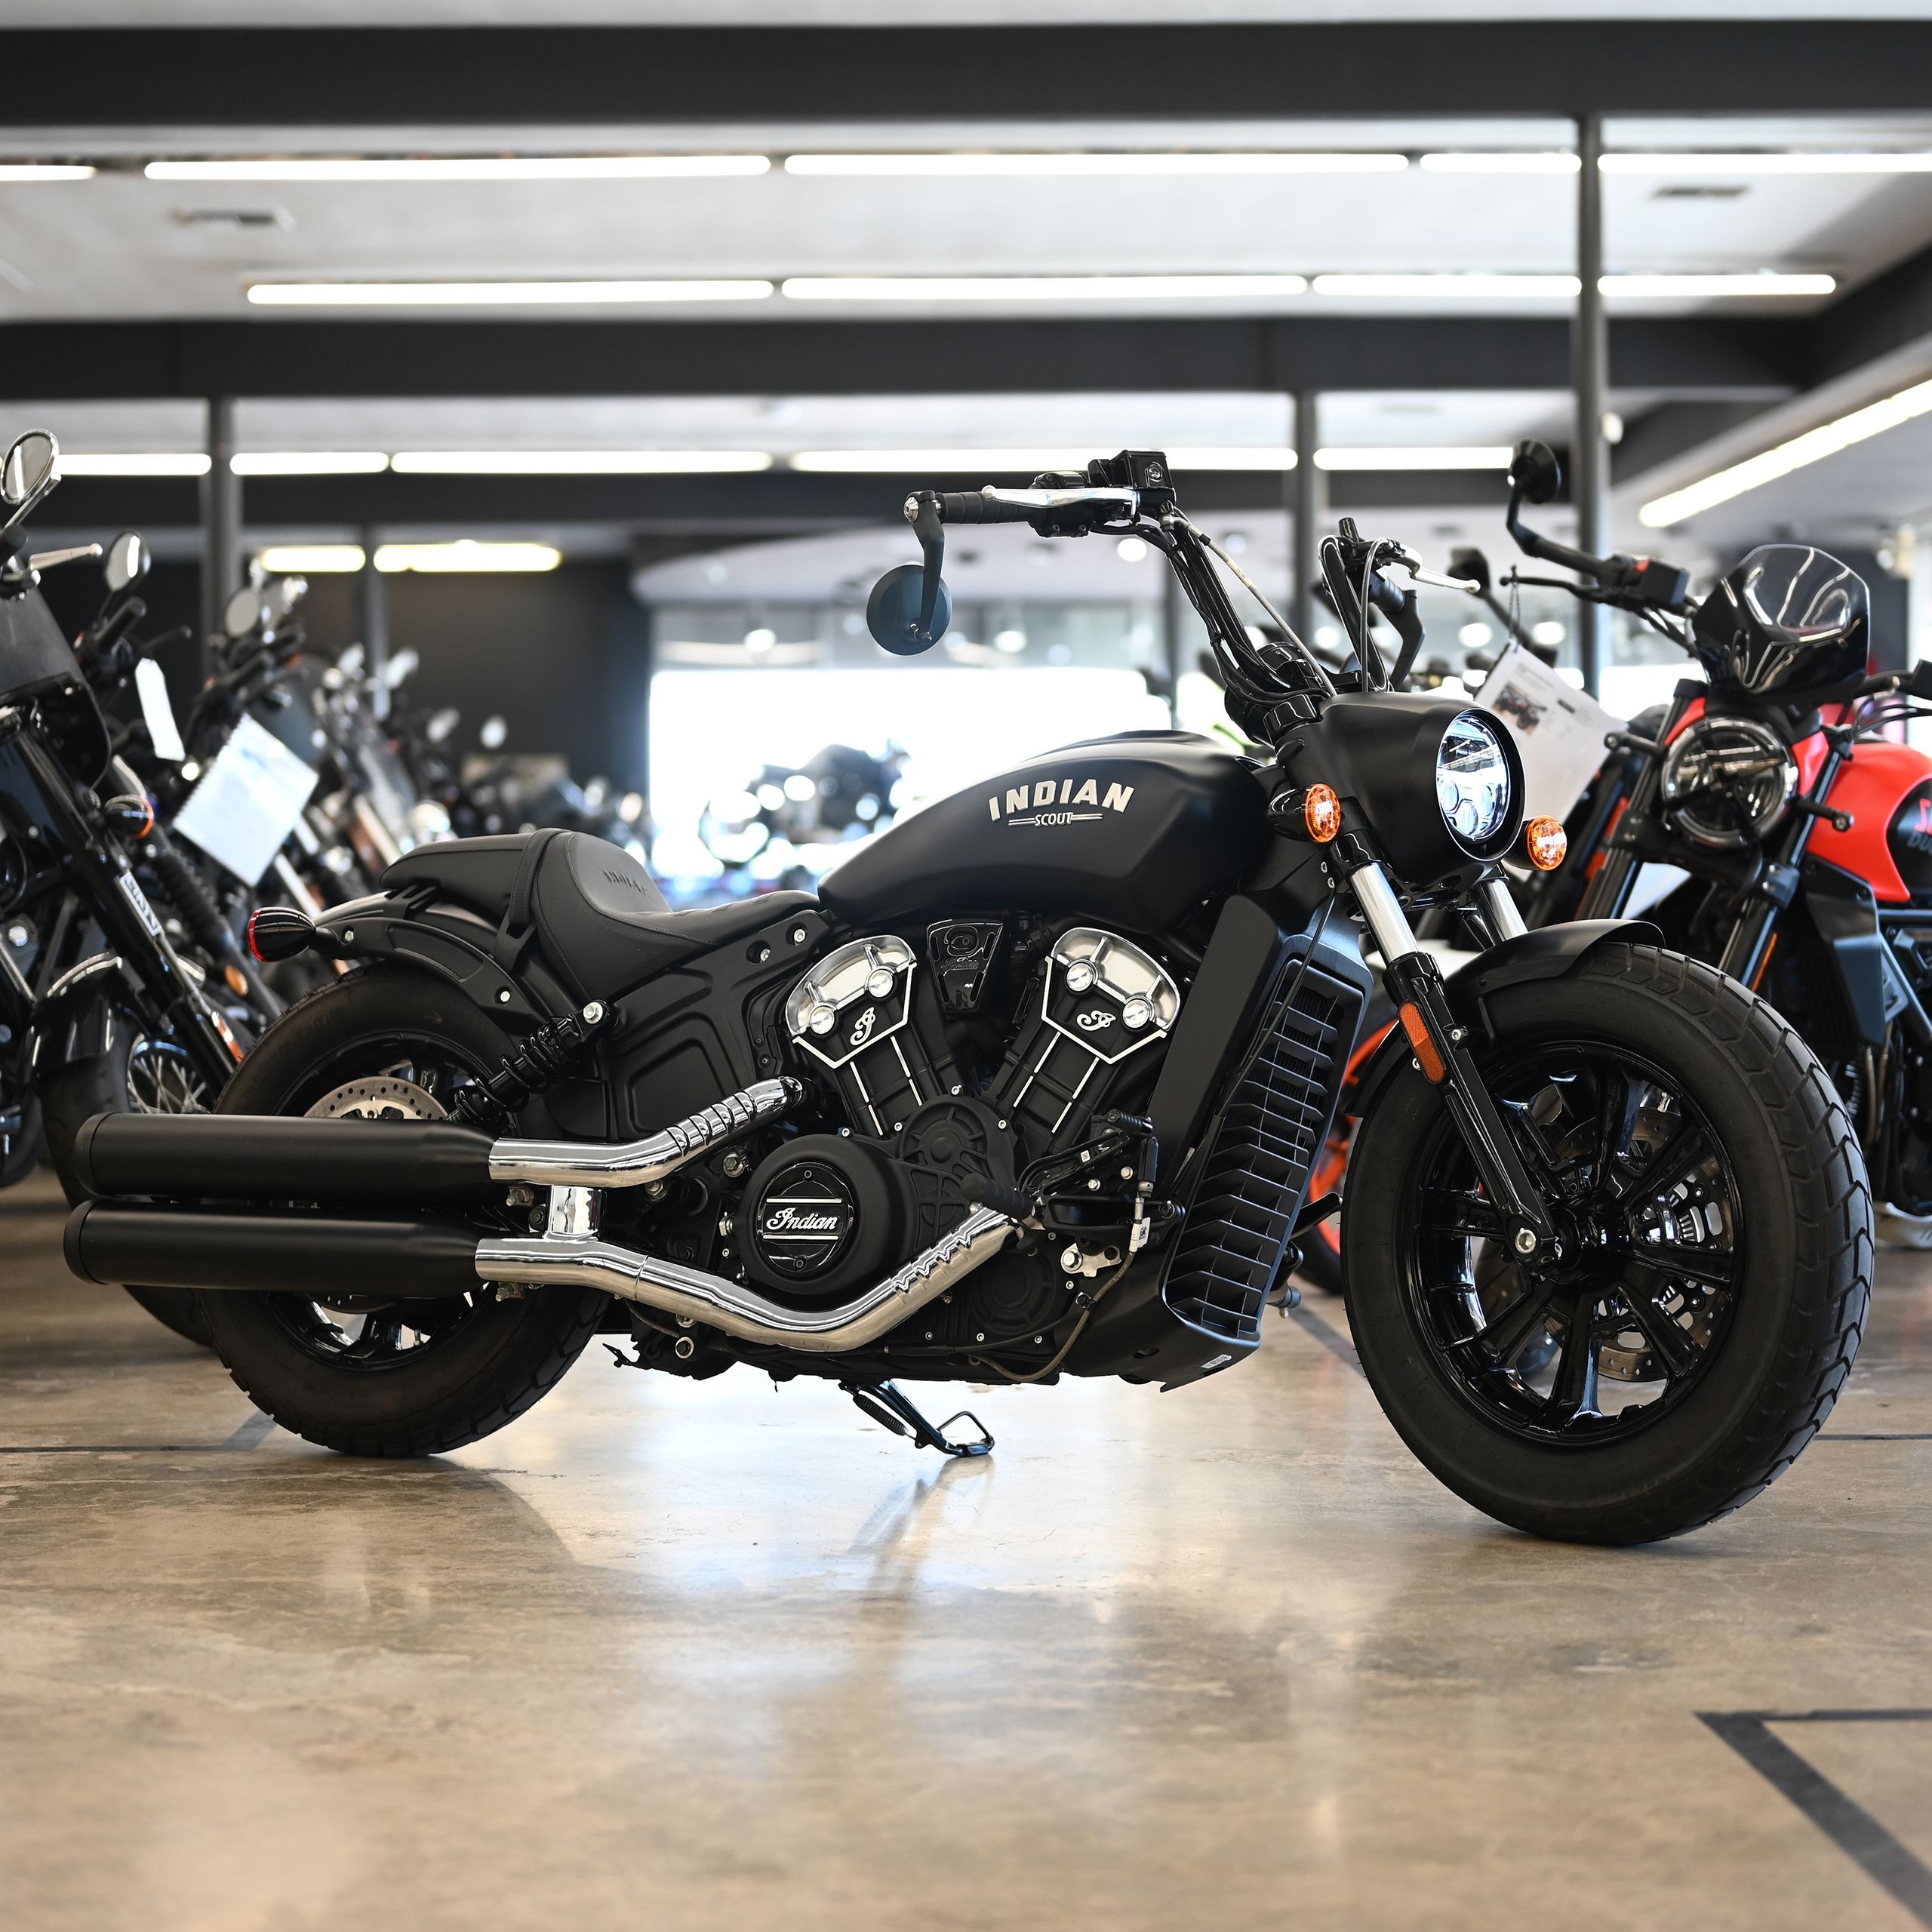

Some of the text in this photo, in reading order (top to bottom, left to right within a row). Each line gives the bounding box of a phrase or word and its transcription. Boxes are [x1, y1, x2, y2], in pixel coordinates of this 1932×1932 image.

[989, 779, 1135, 822] INDIAN
[1035, 812, 1073, 826] SCOUT
[766, 1208, 838, 1230] Indian
